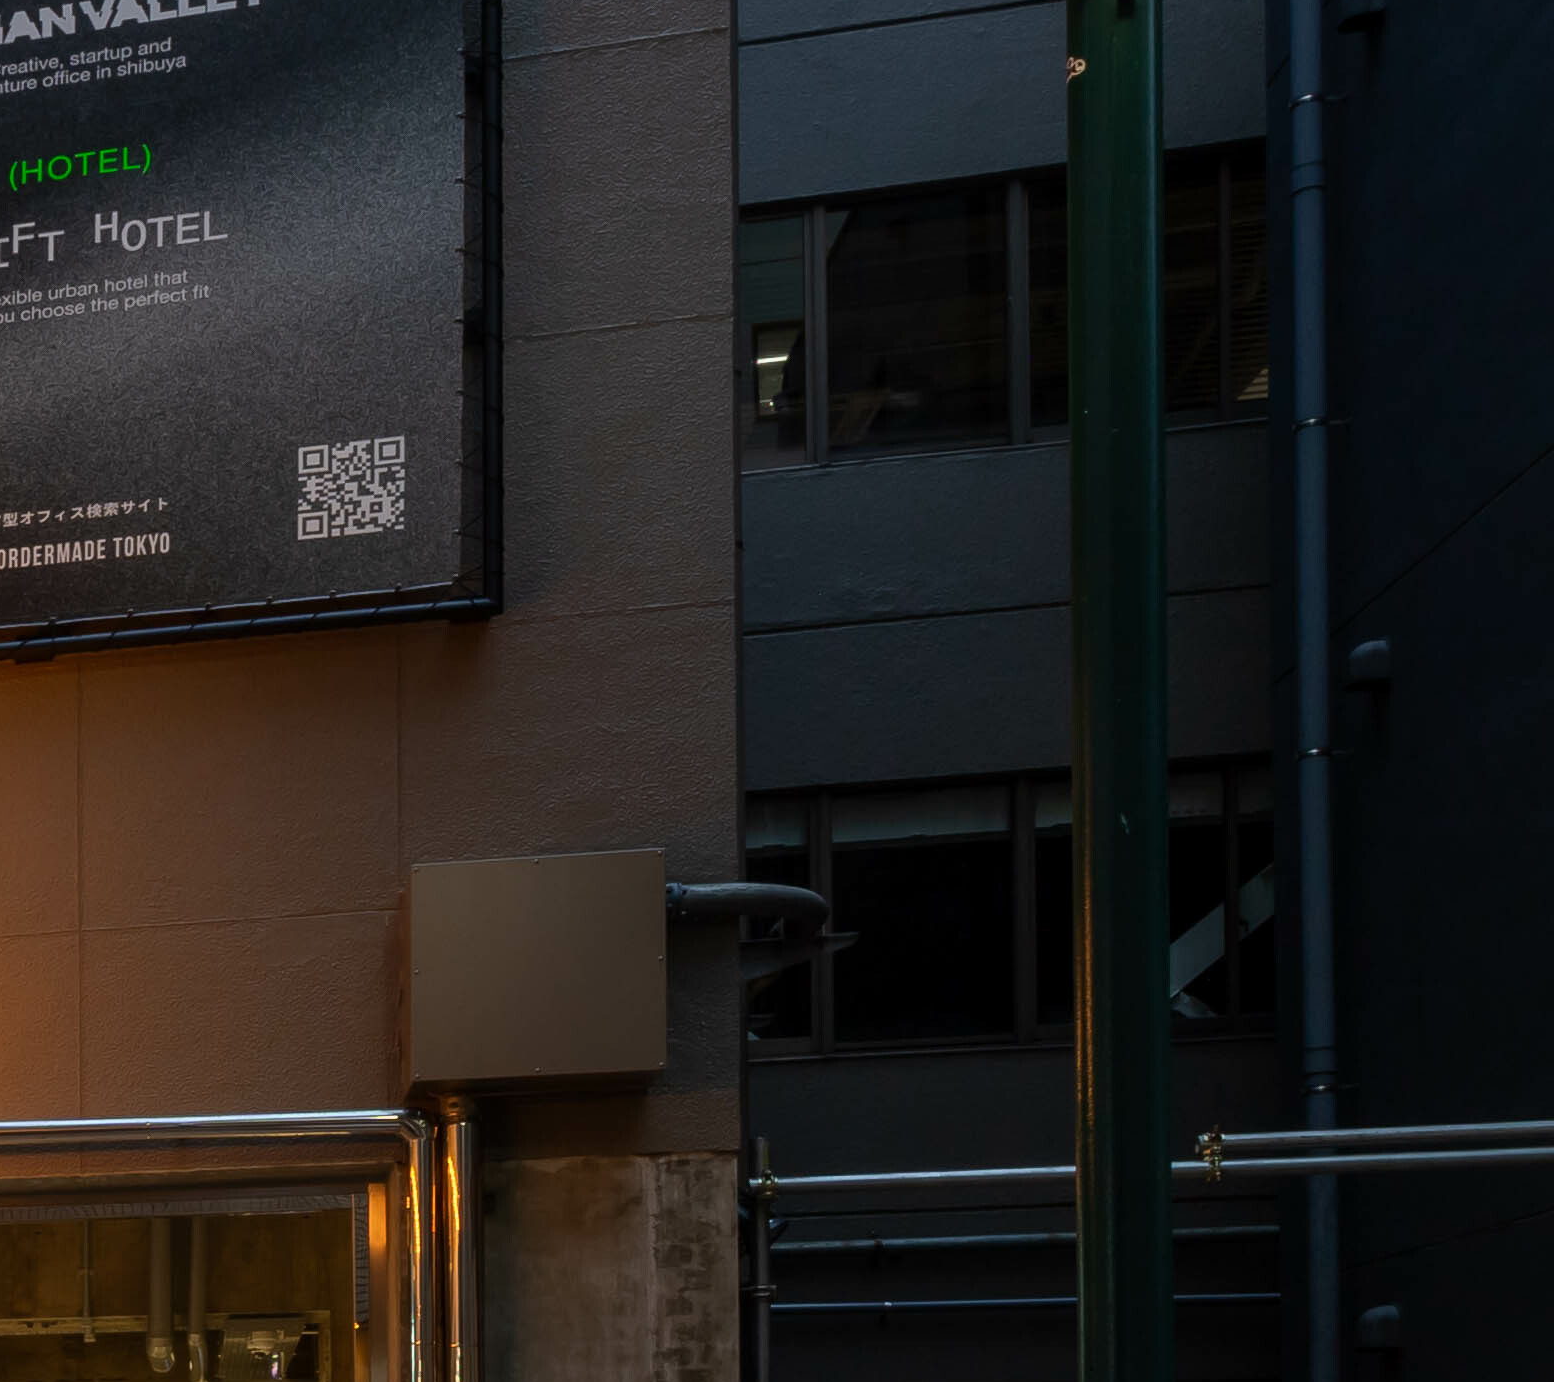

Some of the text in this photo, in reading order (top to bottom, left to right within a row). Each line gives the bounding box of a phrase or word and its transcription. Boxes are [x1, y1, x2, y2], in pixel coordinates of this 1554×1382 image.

[69, 45, 132, 68] startup
[137, 36, 172, 57] and
[42, 68, 91, 90] office
[95, 64, 113, 80] in
[116, 53, 188, 81] shibuya
[7, 142, 154, 193] (HOTEL)
[93, 209, 229, 253] HOTEL
[20, 302, 87, 323] choose
[90, 297, 119, 315] the
[124, 288, 188, 315] perfect
[190, 284, 211, 301] fit
[47, 281, 100, 302] urban
[104, 273, 149, 294] hotel
[153, 269, 190, 289] that
[112, 531, 171, 559] TOKYO
